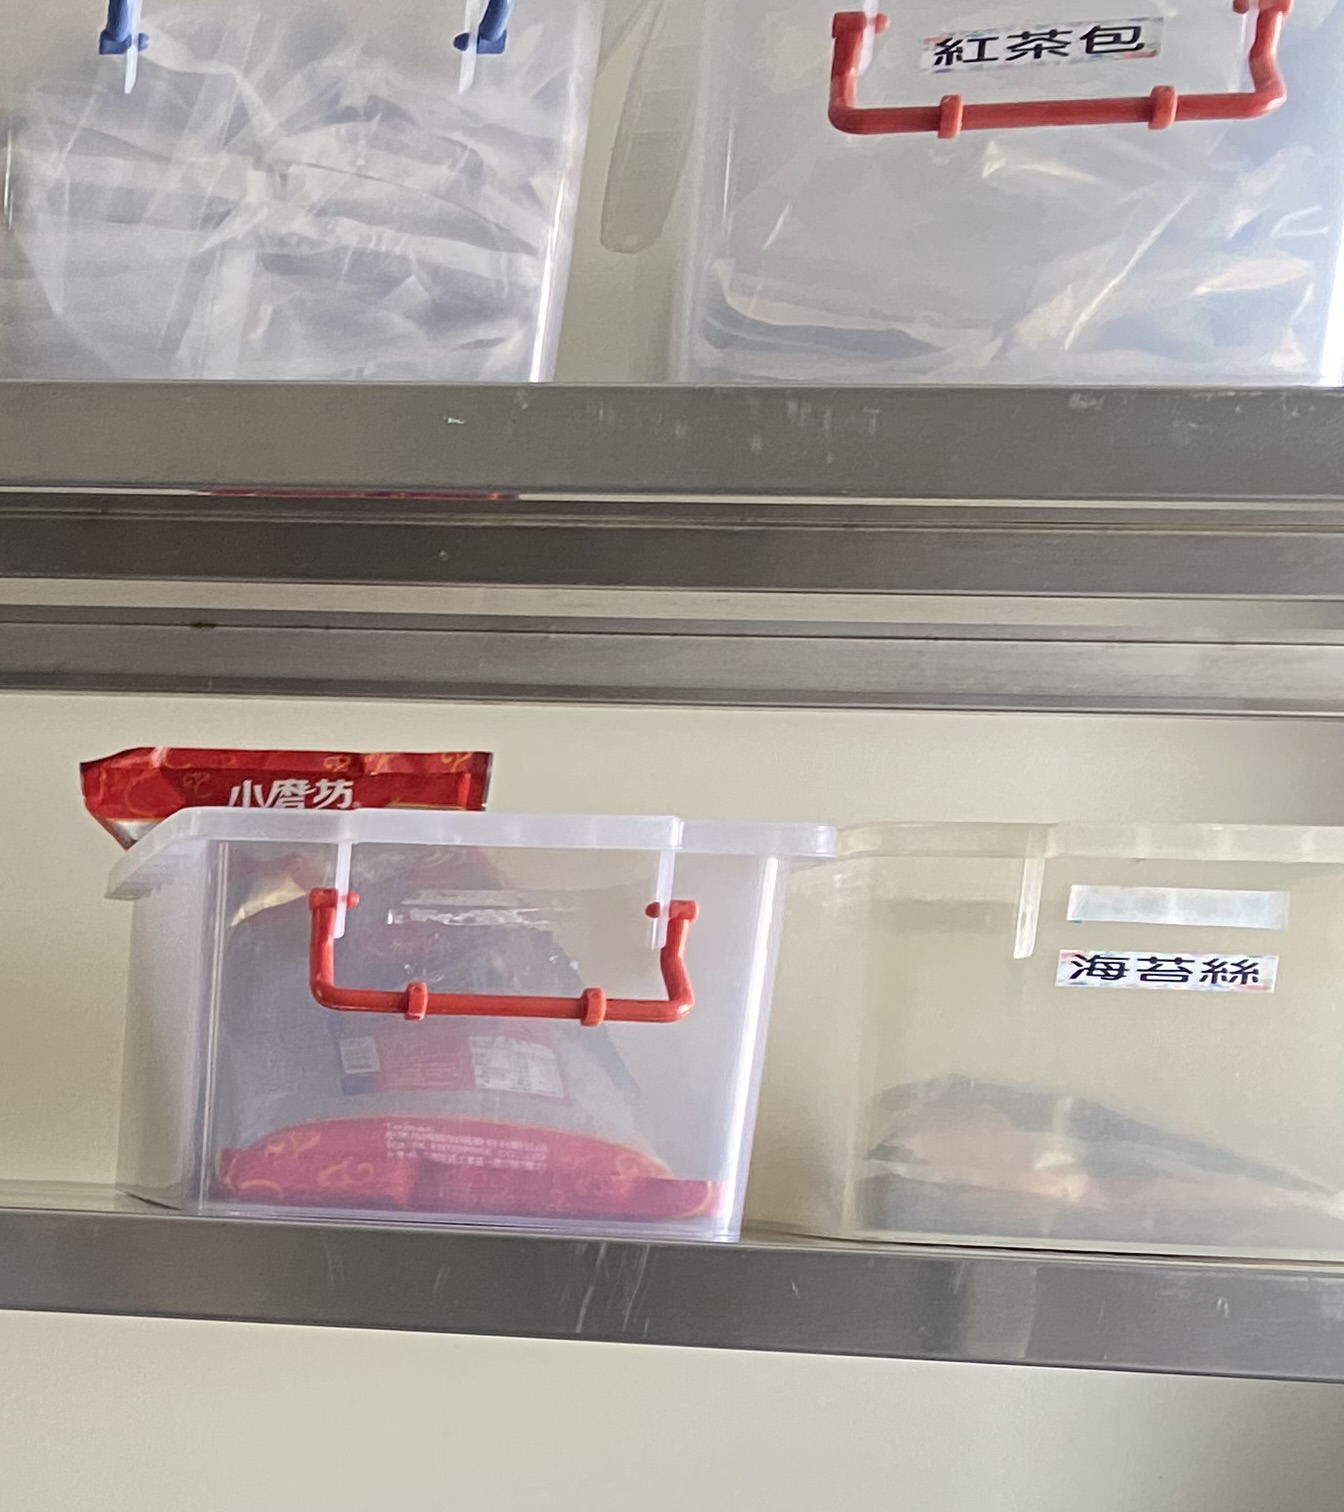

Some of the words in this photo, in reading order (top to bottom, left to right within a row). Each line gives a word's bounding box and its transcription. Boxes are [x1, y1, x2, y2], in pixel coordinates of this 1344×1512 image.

[933, 24, 1145, 67] 紅茶包
[228, 778, 354, 809] 小磨坊
[1069, 954, 1260, 986] 海苔絲
